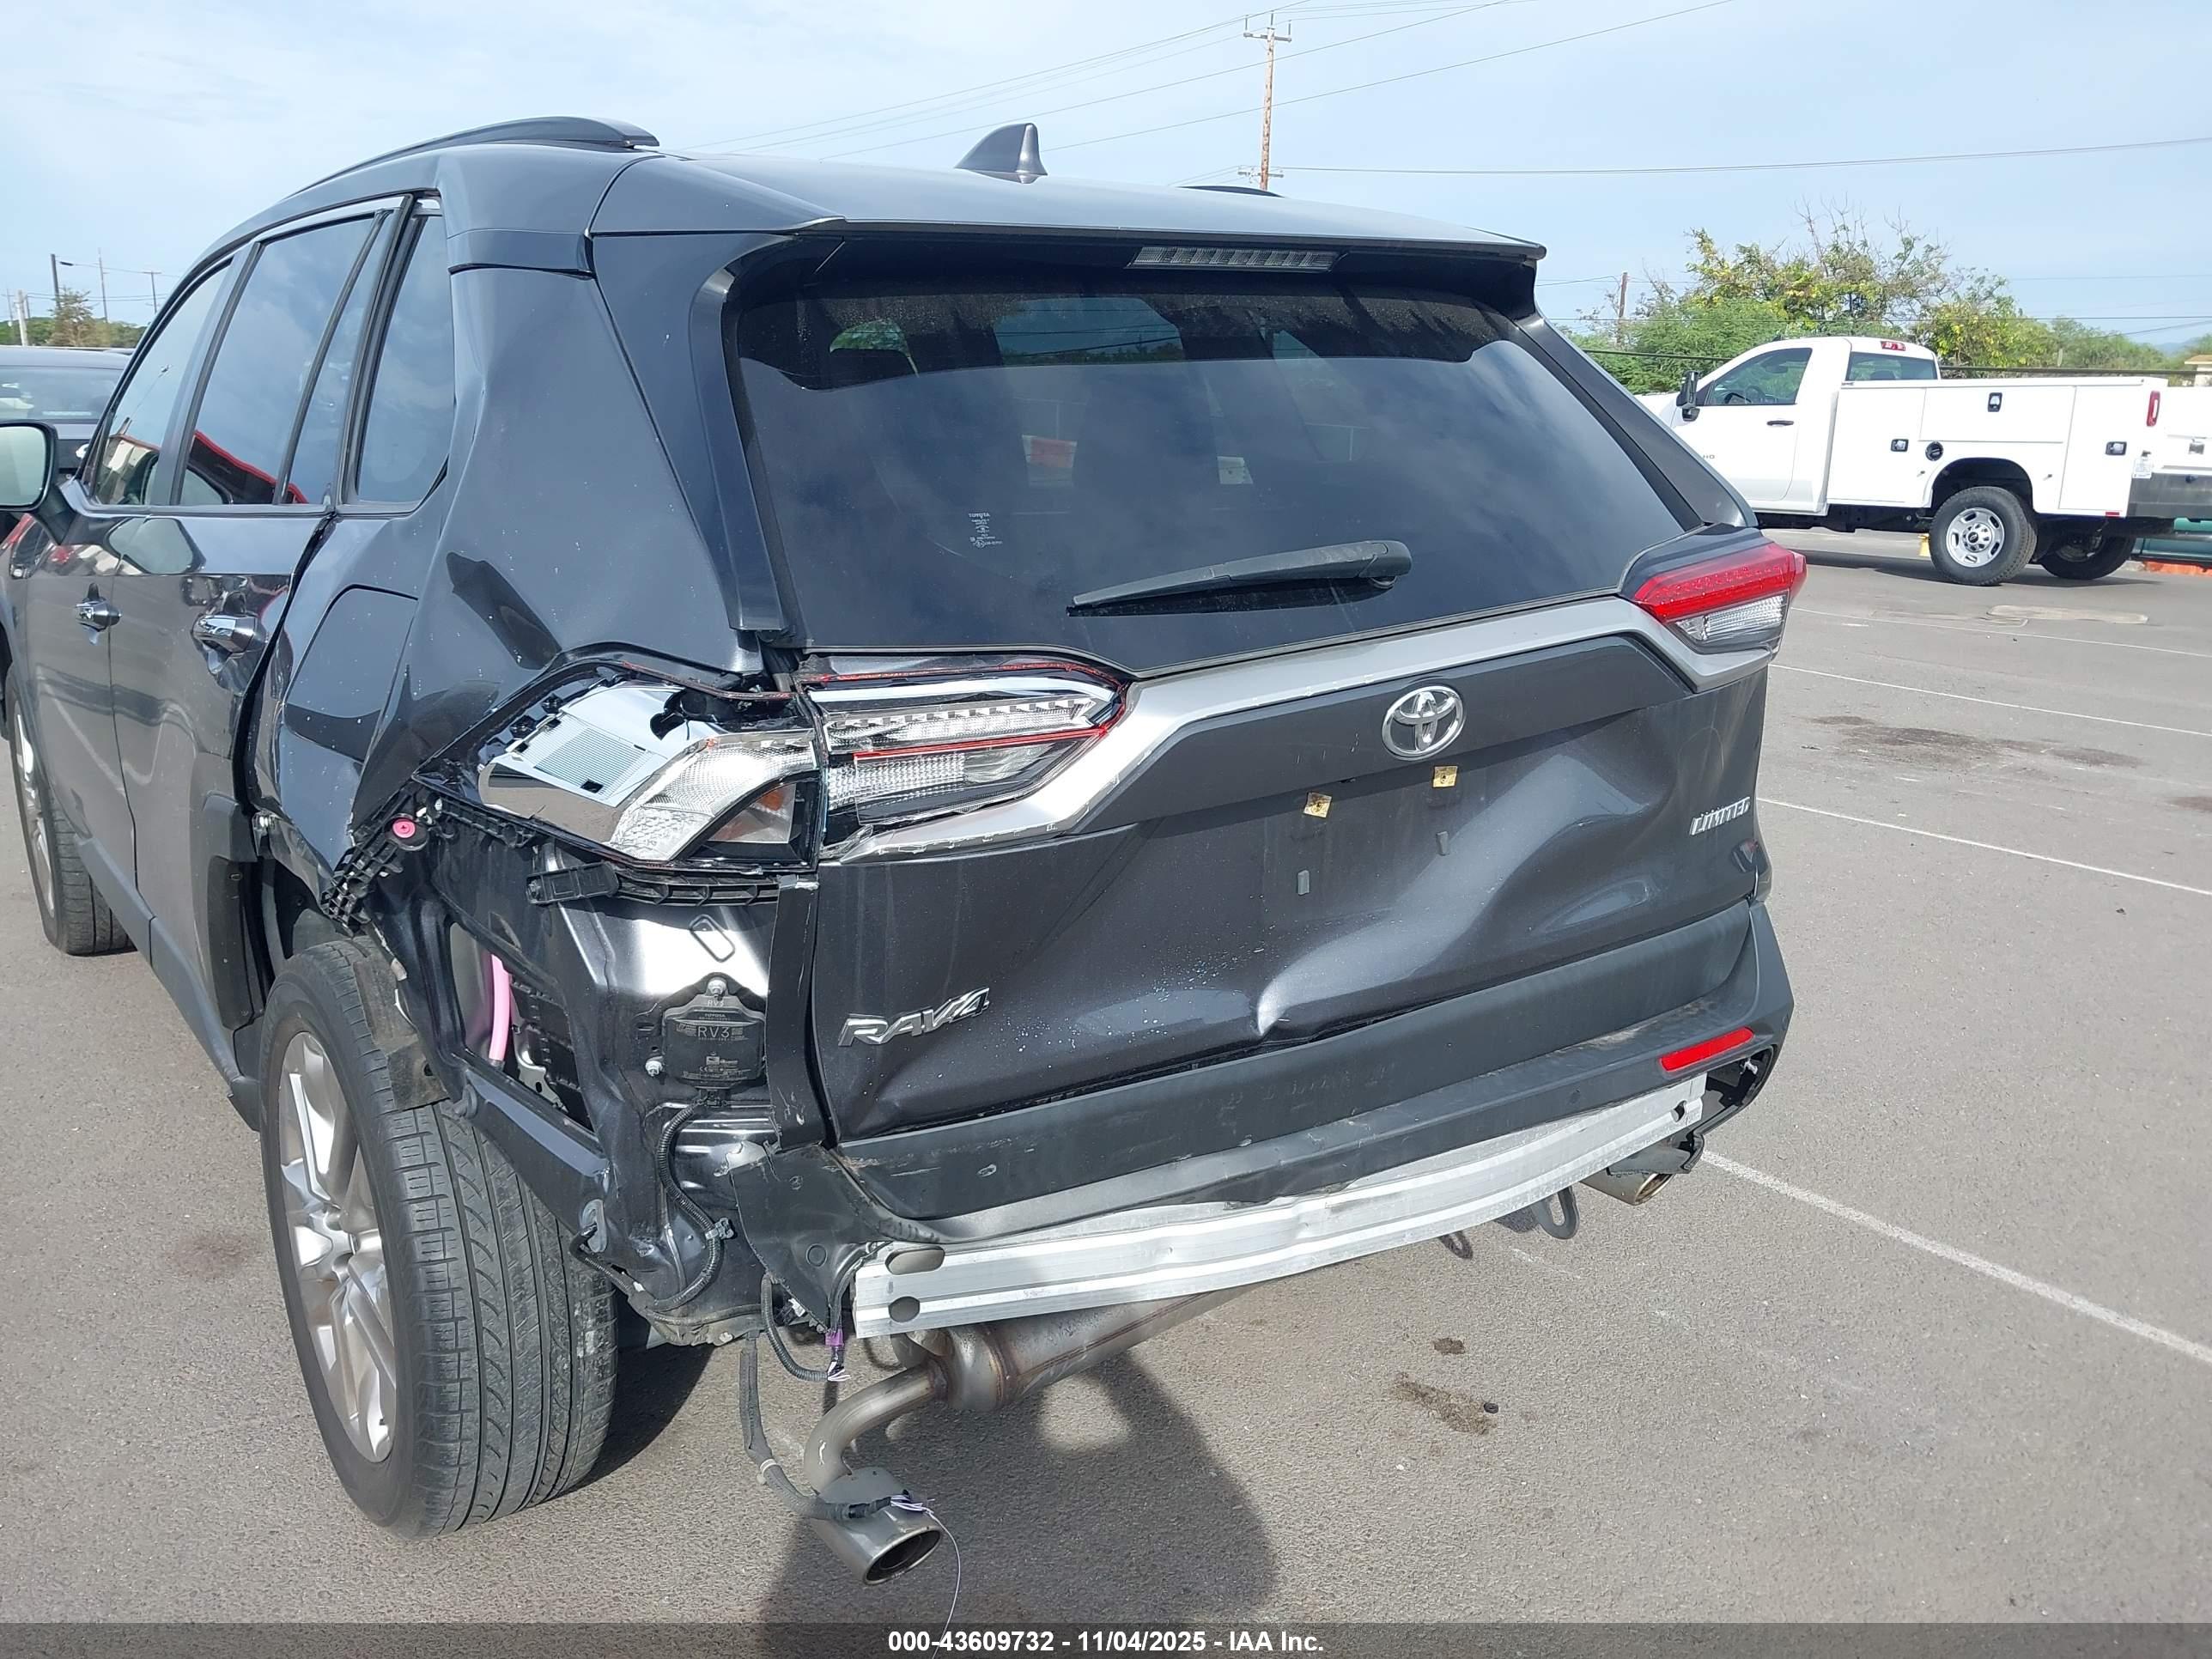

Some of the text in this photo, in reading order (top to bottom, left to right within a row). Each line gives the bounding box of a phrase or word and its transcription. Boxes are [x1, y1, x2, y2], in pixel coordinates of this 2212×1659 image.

[1689, 796, 1751, 836] LIMITED
[697, 1026, 731, 1038] RV3
[838, 988, 990, 1047] RAV4
